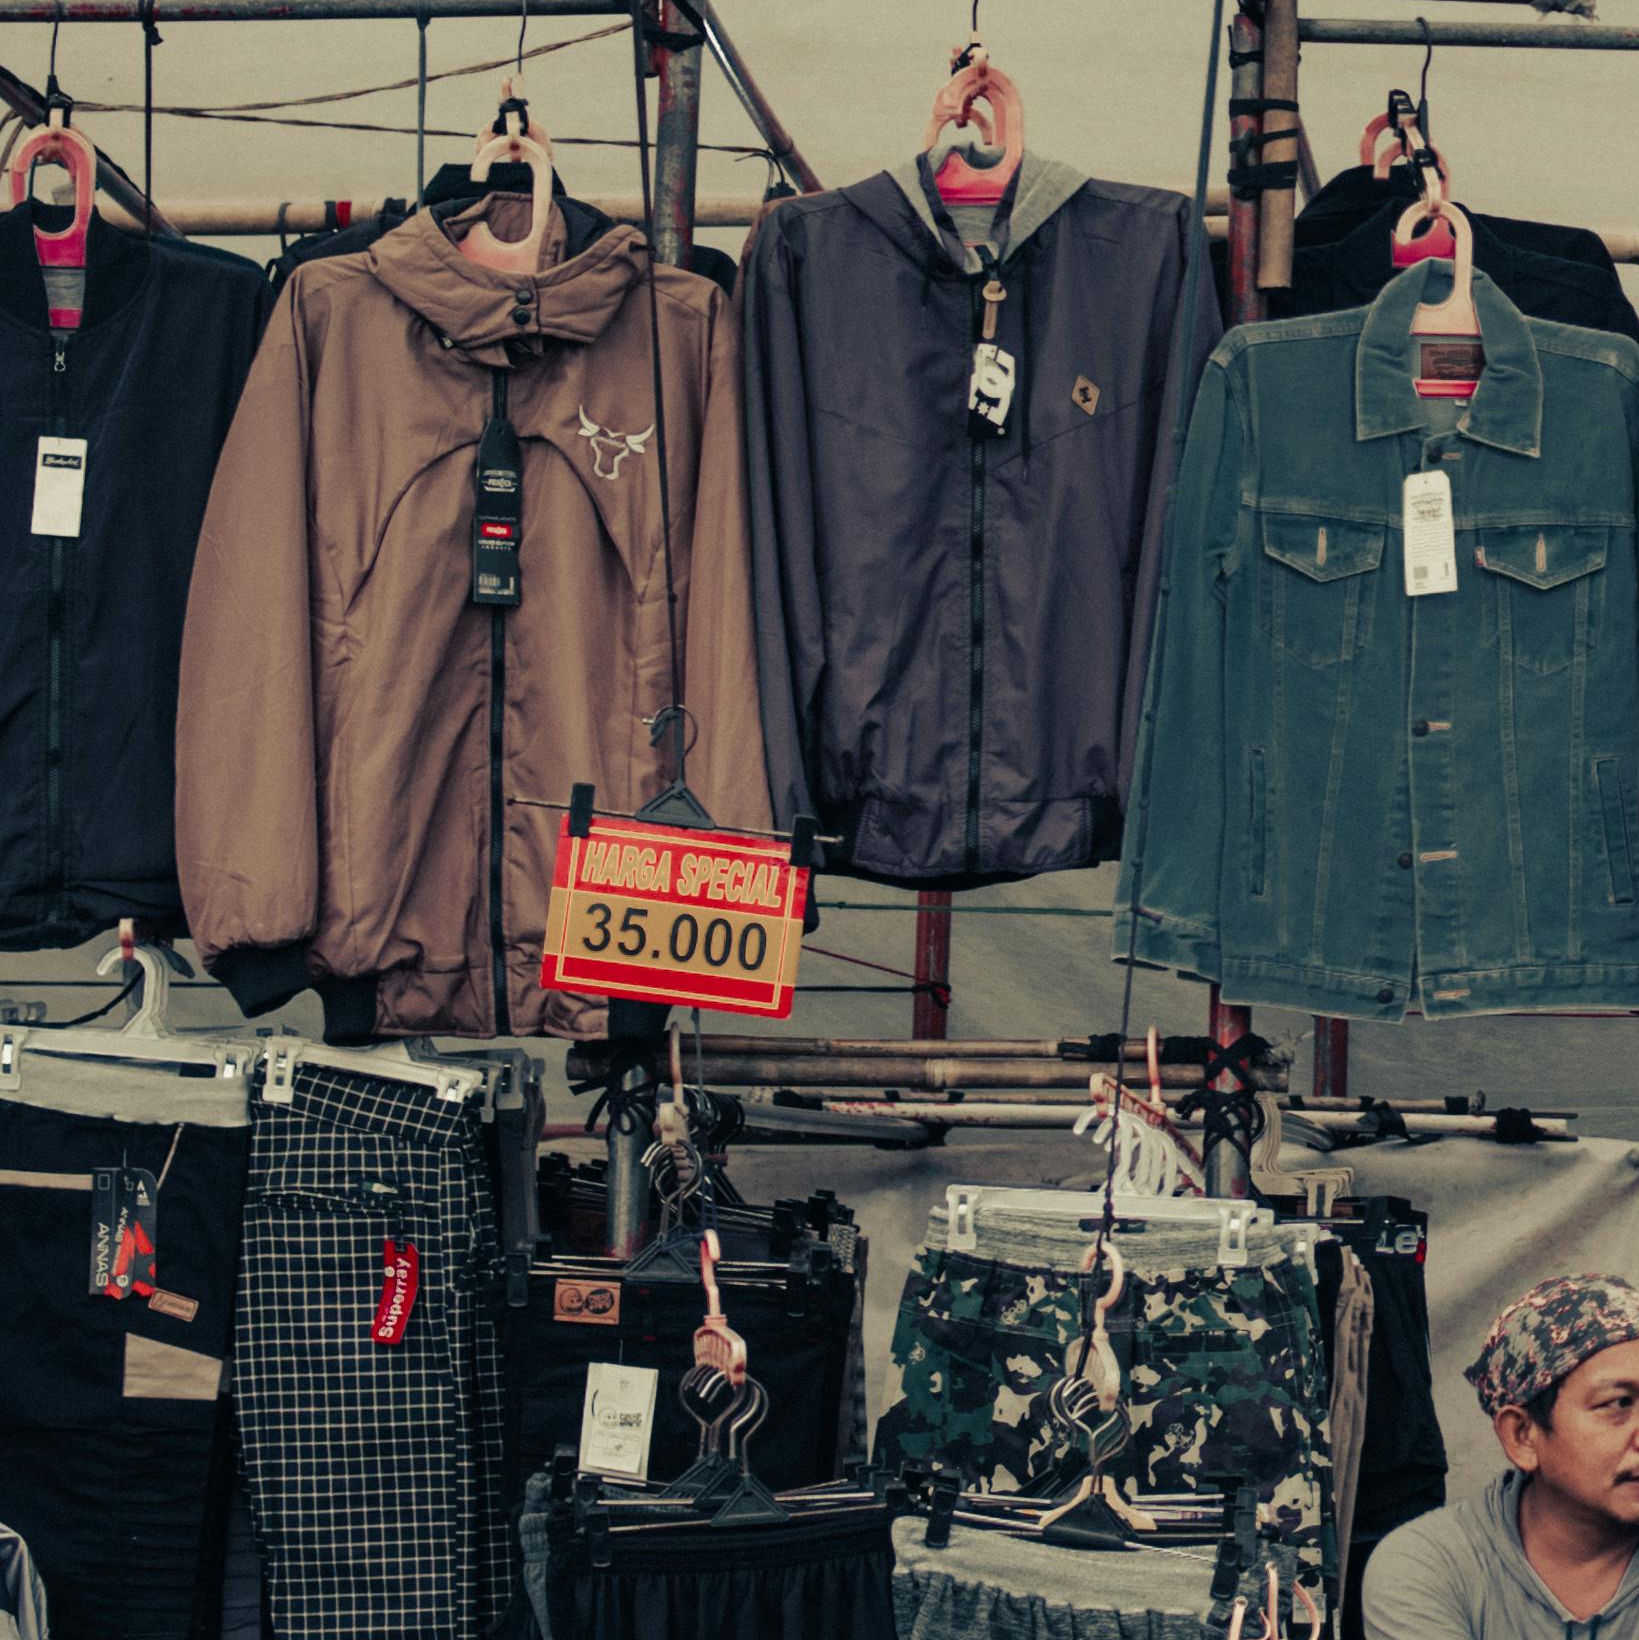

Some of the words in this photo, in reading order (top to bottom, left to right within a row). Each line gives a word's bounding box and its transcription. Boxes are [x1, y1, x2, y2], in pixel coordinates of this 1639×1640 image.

[581, 840, 672, 893] HARGA
[676, 853, 781, 908] SPECIAL
[582, 903, 767, 971] 35.000
[96, 1222, 110, 1287] ANNAS
